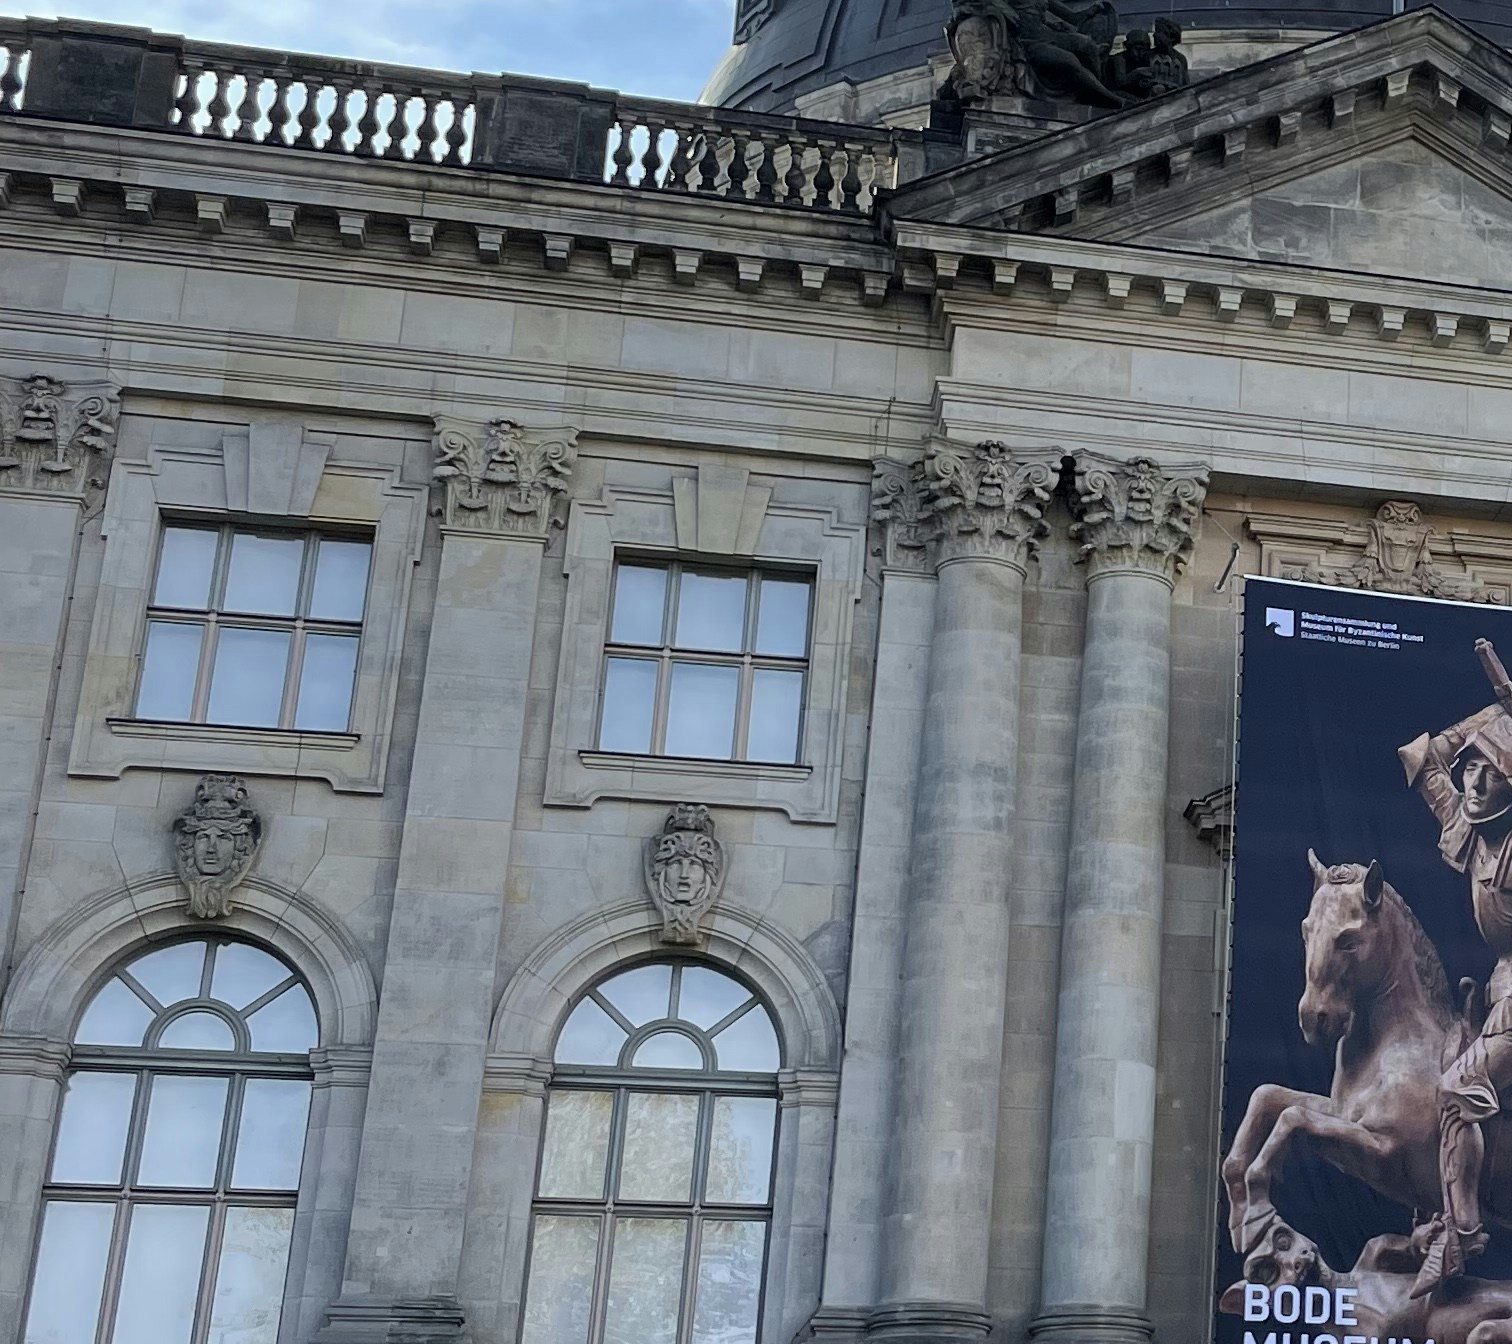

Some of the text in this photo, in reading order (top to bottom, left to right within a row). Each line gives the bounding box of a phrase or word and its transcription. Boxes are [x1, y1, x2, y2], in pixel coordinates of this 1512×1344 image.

[1301, 621, 1333, 631] Museum
[1402, 633, 1424, 642] Kunst
[1377, 641, 1400, 650] Berlin
[1243, 1283, 1359, 1326] BODE
